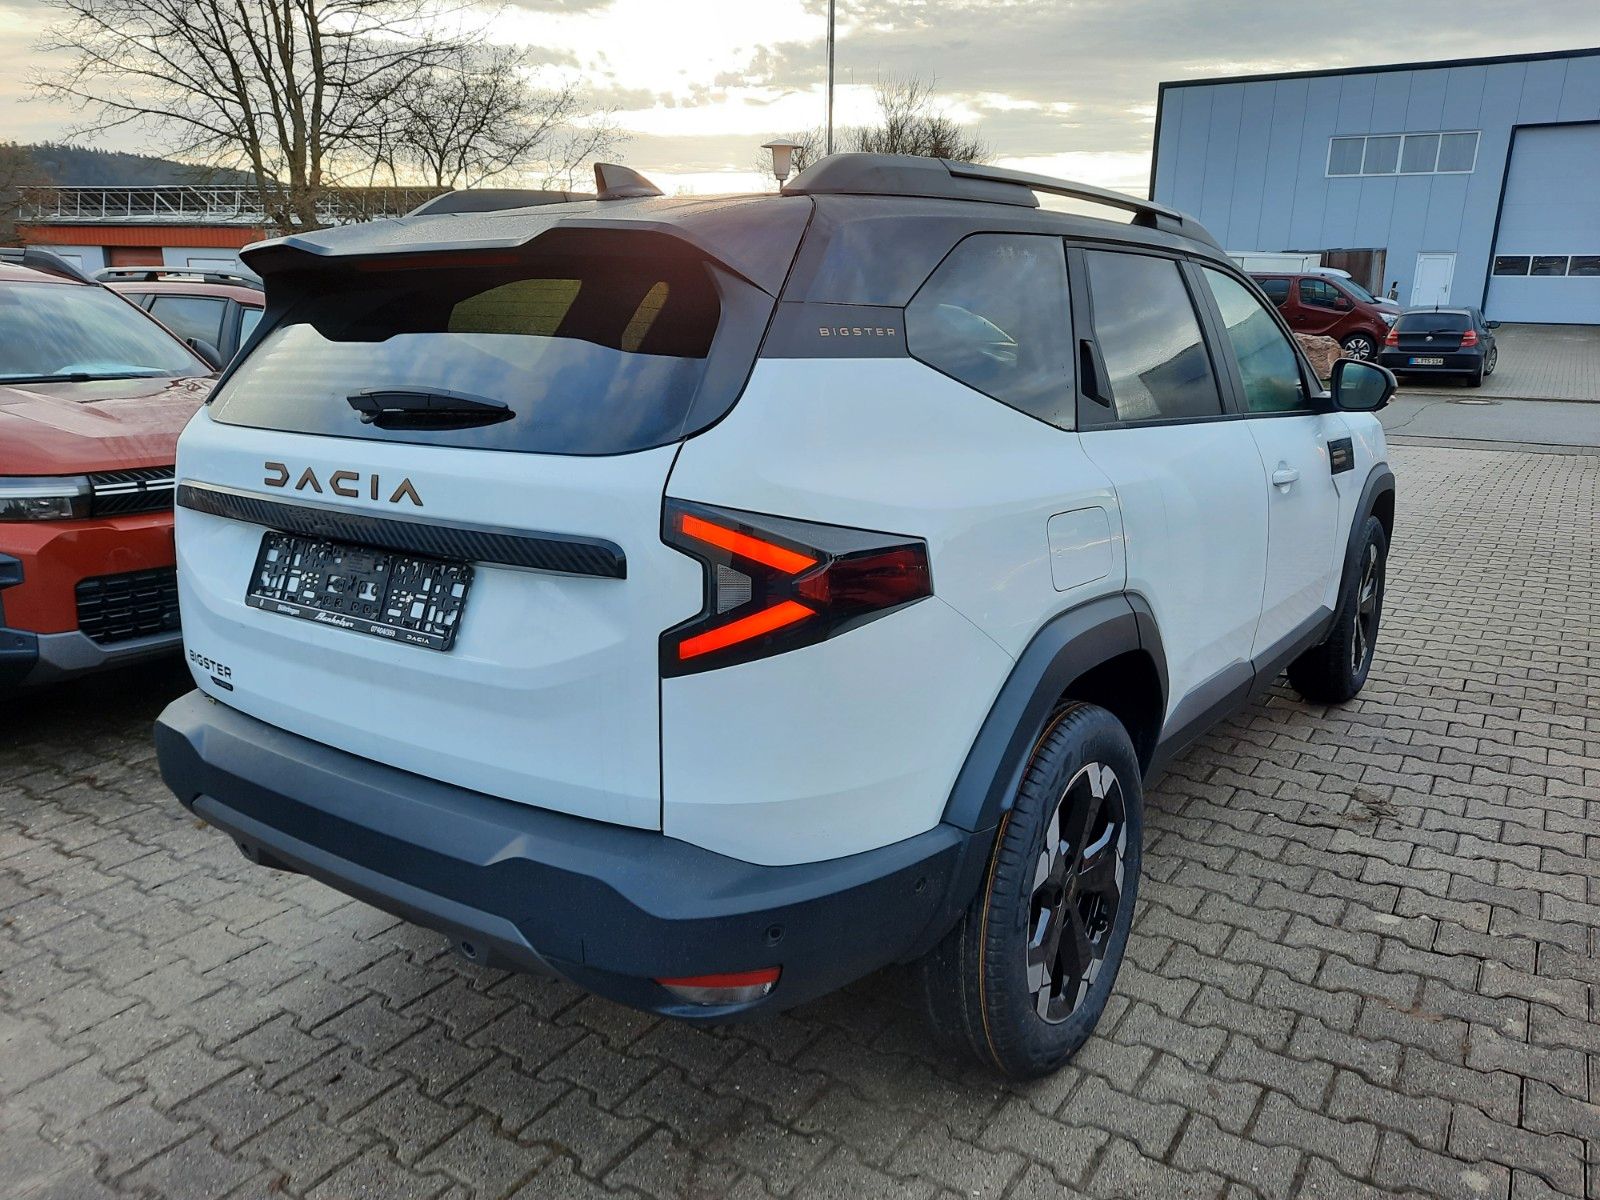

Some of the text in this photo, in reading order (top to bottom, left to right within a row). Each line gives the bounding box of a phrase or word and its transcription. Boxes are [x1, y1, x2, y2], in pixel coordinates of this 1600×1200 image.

[819, 327, 896, 337] BIGSTER
[264, 461, 424, 507] DACIA
[406, 633, 430, 644] DACIA
[189, 648, 232, 680] BIGSTER
